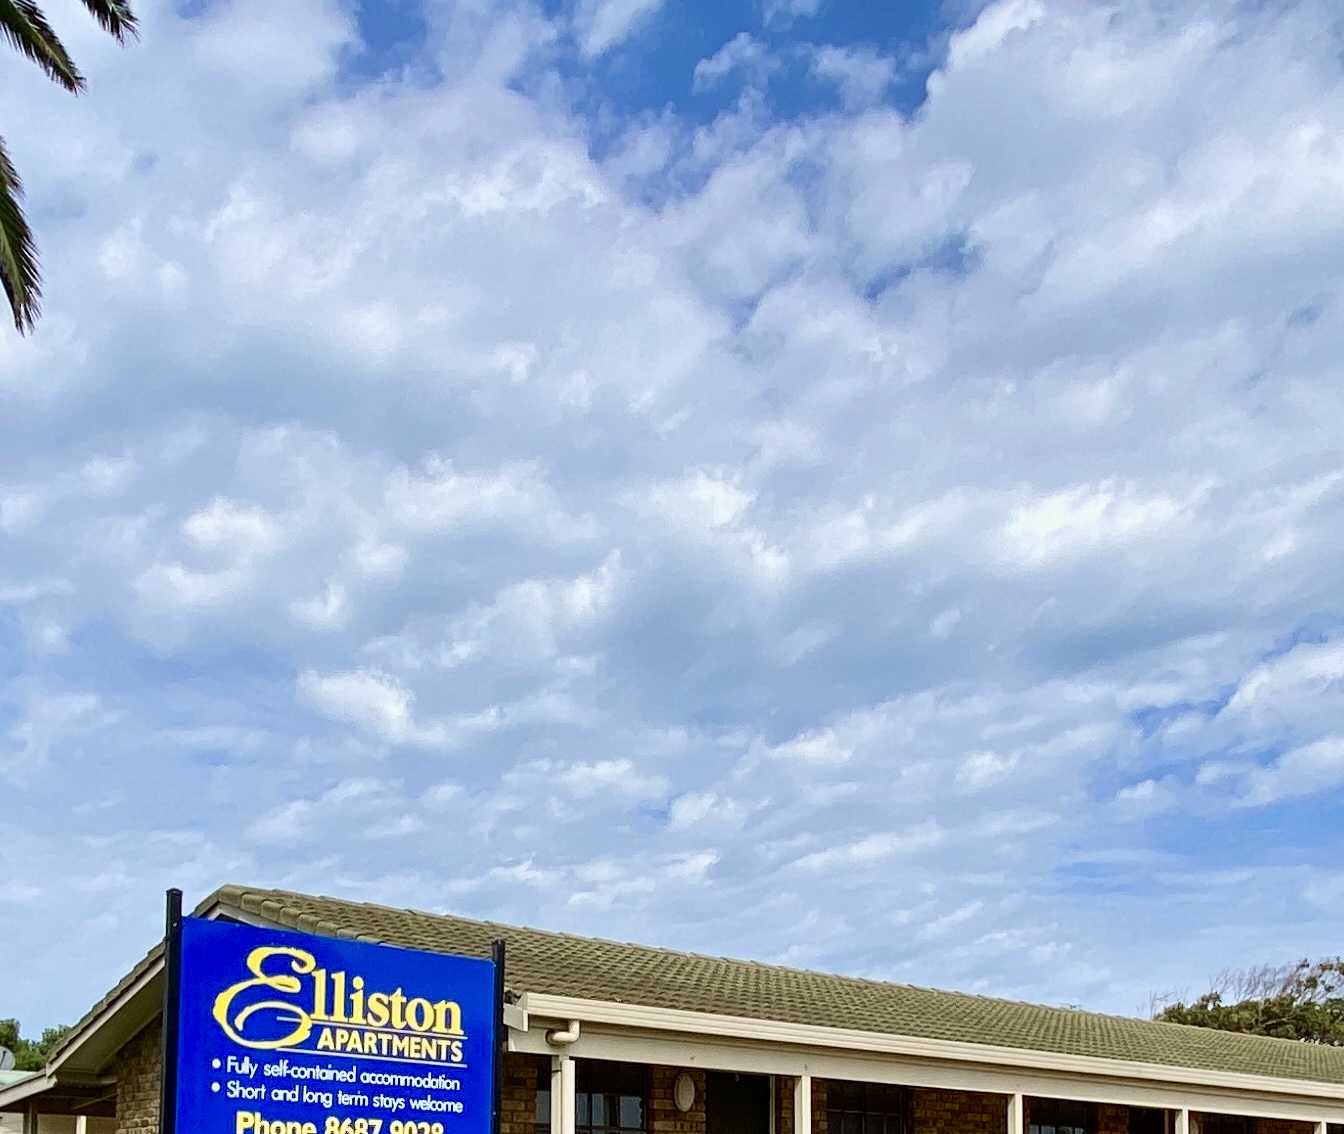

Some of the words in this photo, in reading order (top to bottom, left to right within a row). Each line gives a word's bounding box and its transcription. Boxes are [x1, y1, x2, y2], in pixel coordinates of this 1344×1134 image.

[213, 946, 464, 1050] Elliston
[317, 1028, 464, 1063] APARTMENTS
[227, 1056, 258, 1078] Fully
[264, 1059, 357, 1083] self-contained
[360, 1071, 460, 1091] accommodation
[227, 1080, 266, 1100] Short
[271, 1085, 299, 1101] and
[302, 1085, 332, 1109] long
[338, 1090, 368, 1106] term
[373, 1094, 406, 1113] stays
[409, 1095, 464, 1114] welcome
